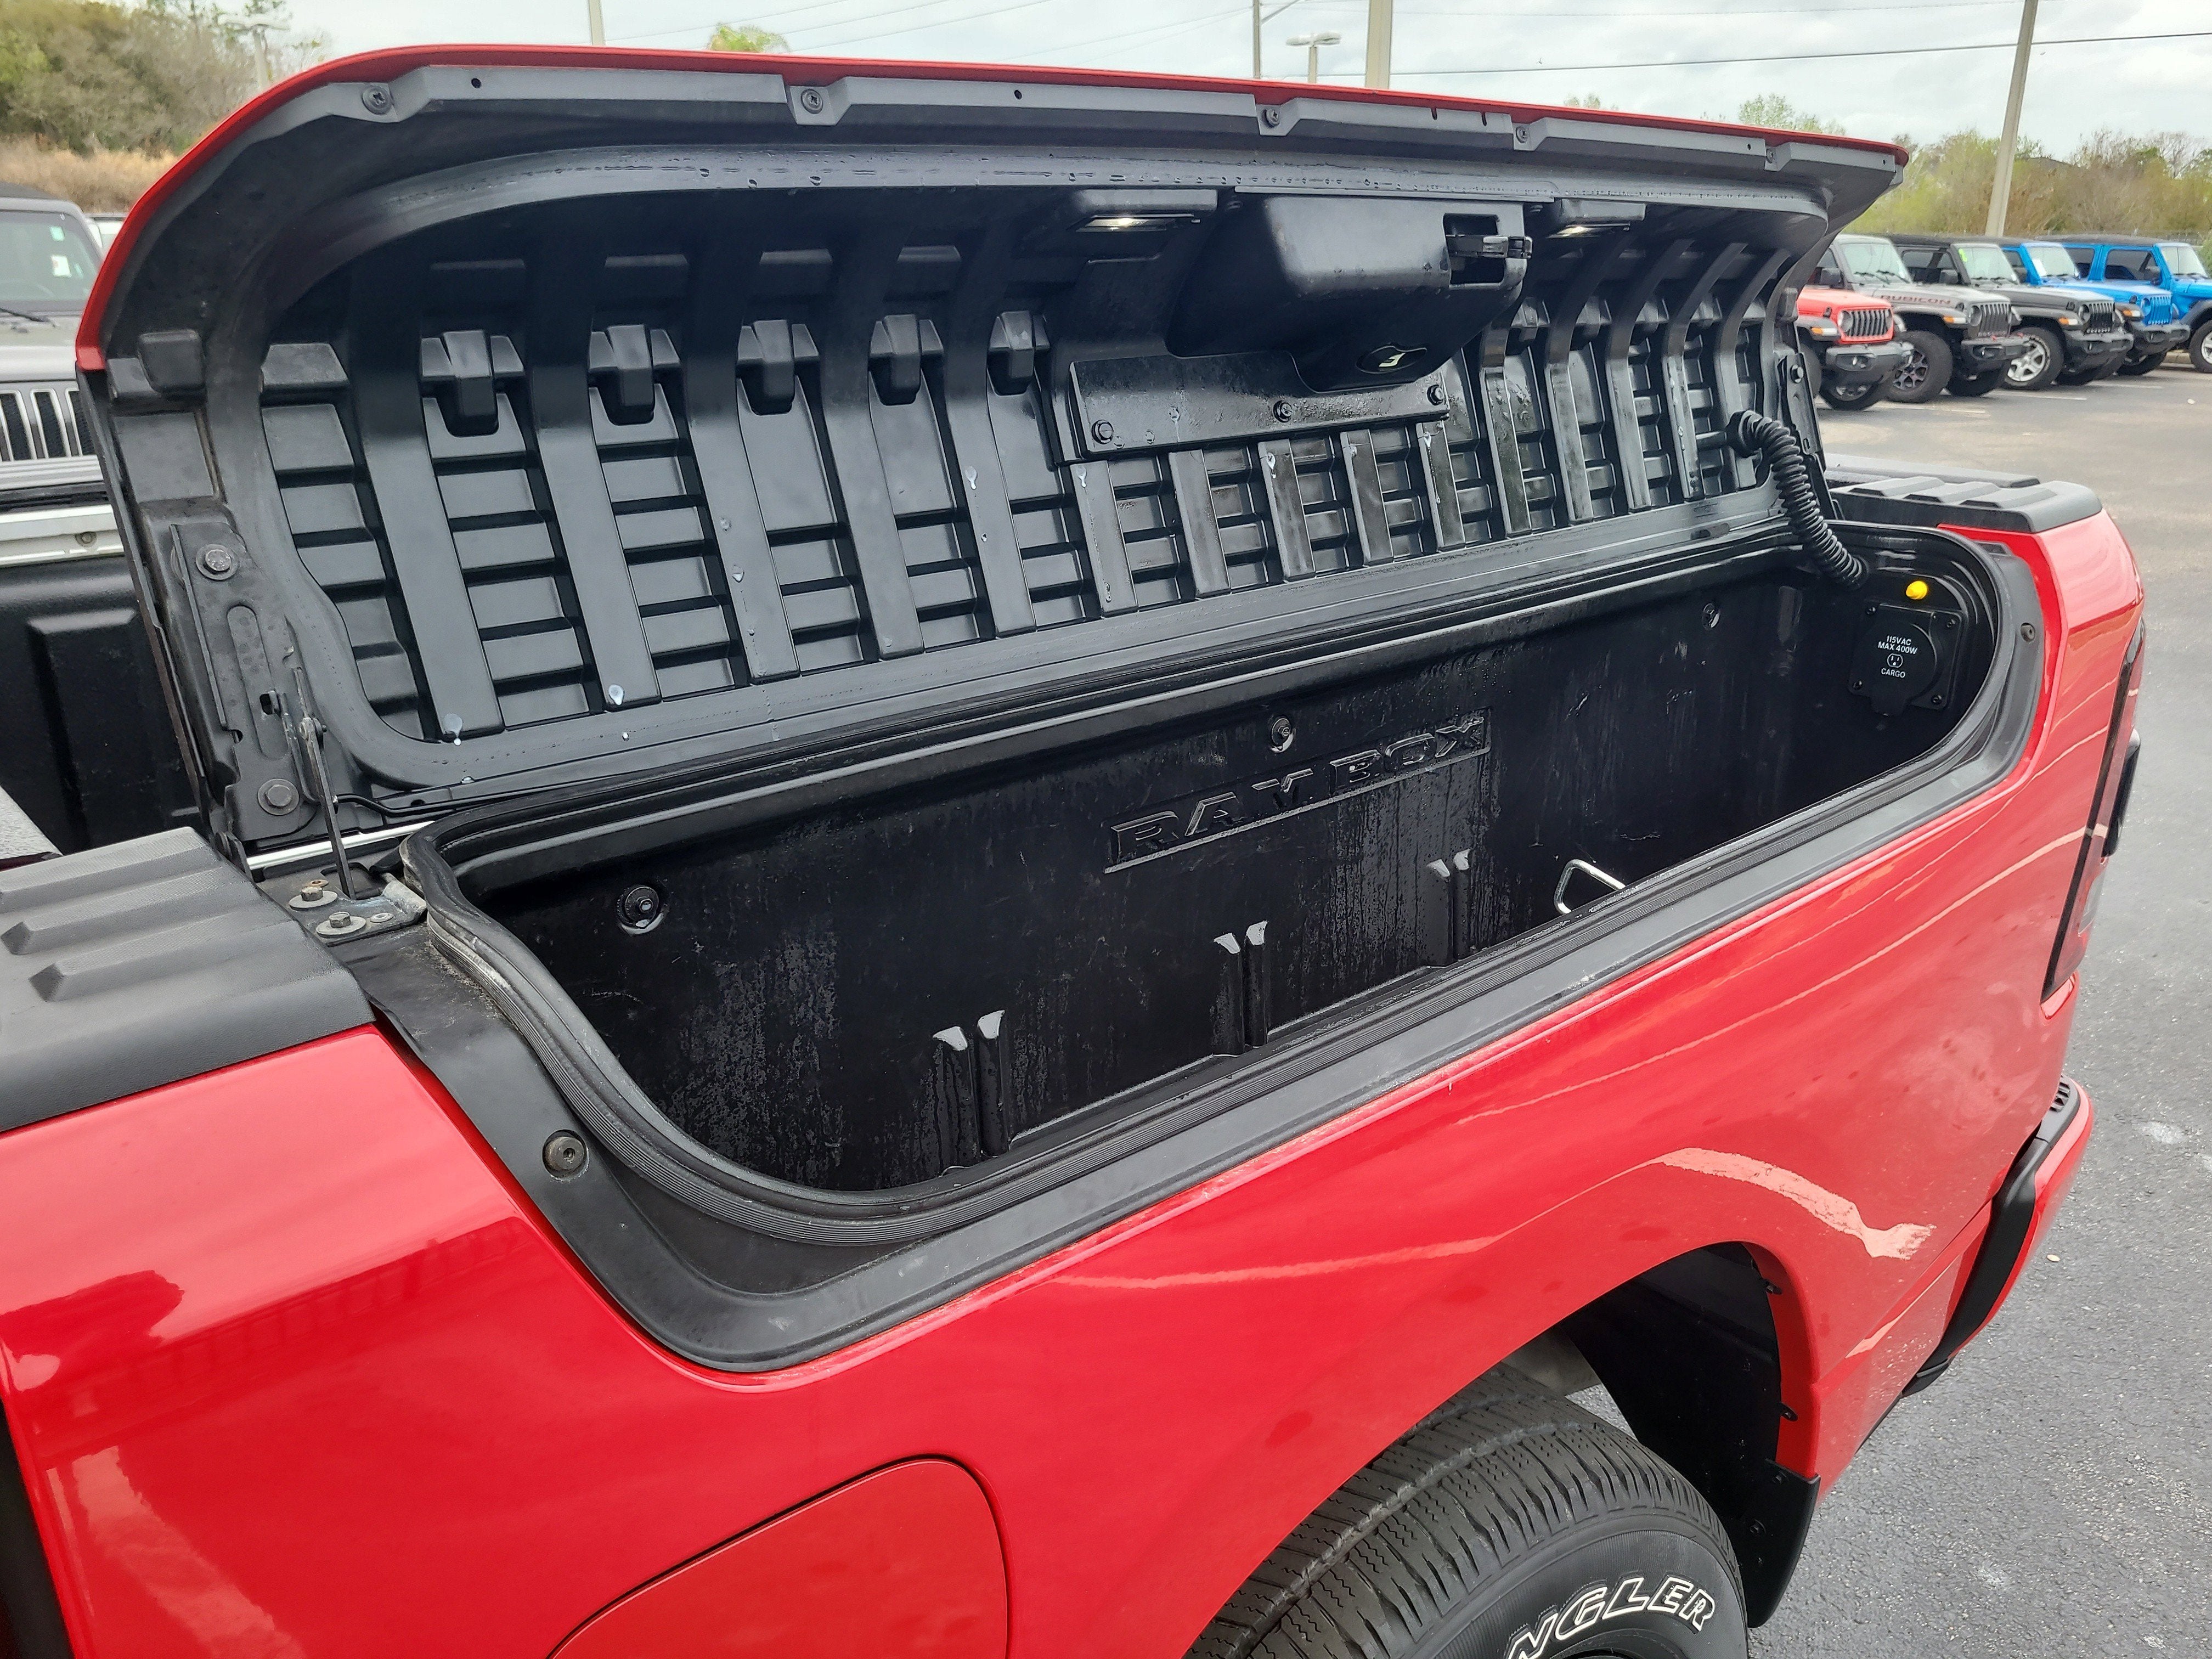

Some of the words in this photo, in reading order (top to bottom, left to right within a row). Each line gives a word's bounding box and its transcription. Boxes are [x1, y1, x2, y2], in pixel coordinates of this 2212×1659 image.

[1881, 295, 1950, 304] RUBICON
[1887, 635, 1911, 646] 115VAC
[1877, 641, 1895, 651] MAX
[1895, 645, 1918, 654] 400W
[1881, 668, 1906, 678] CARGO
